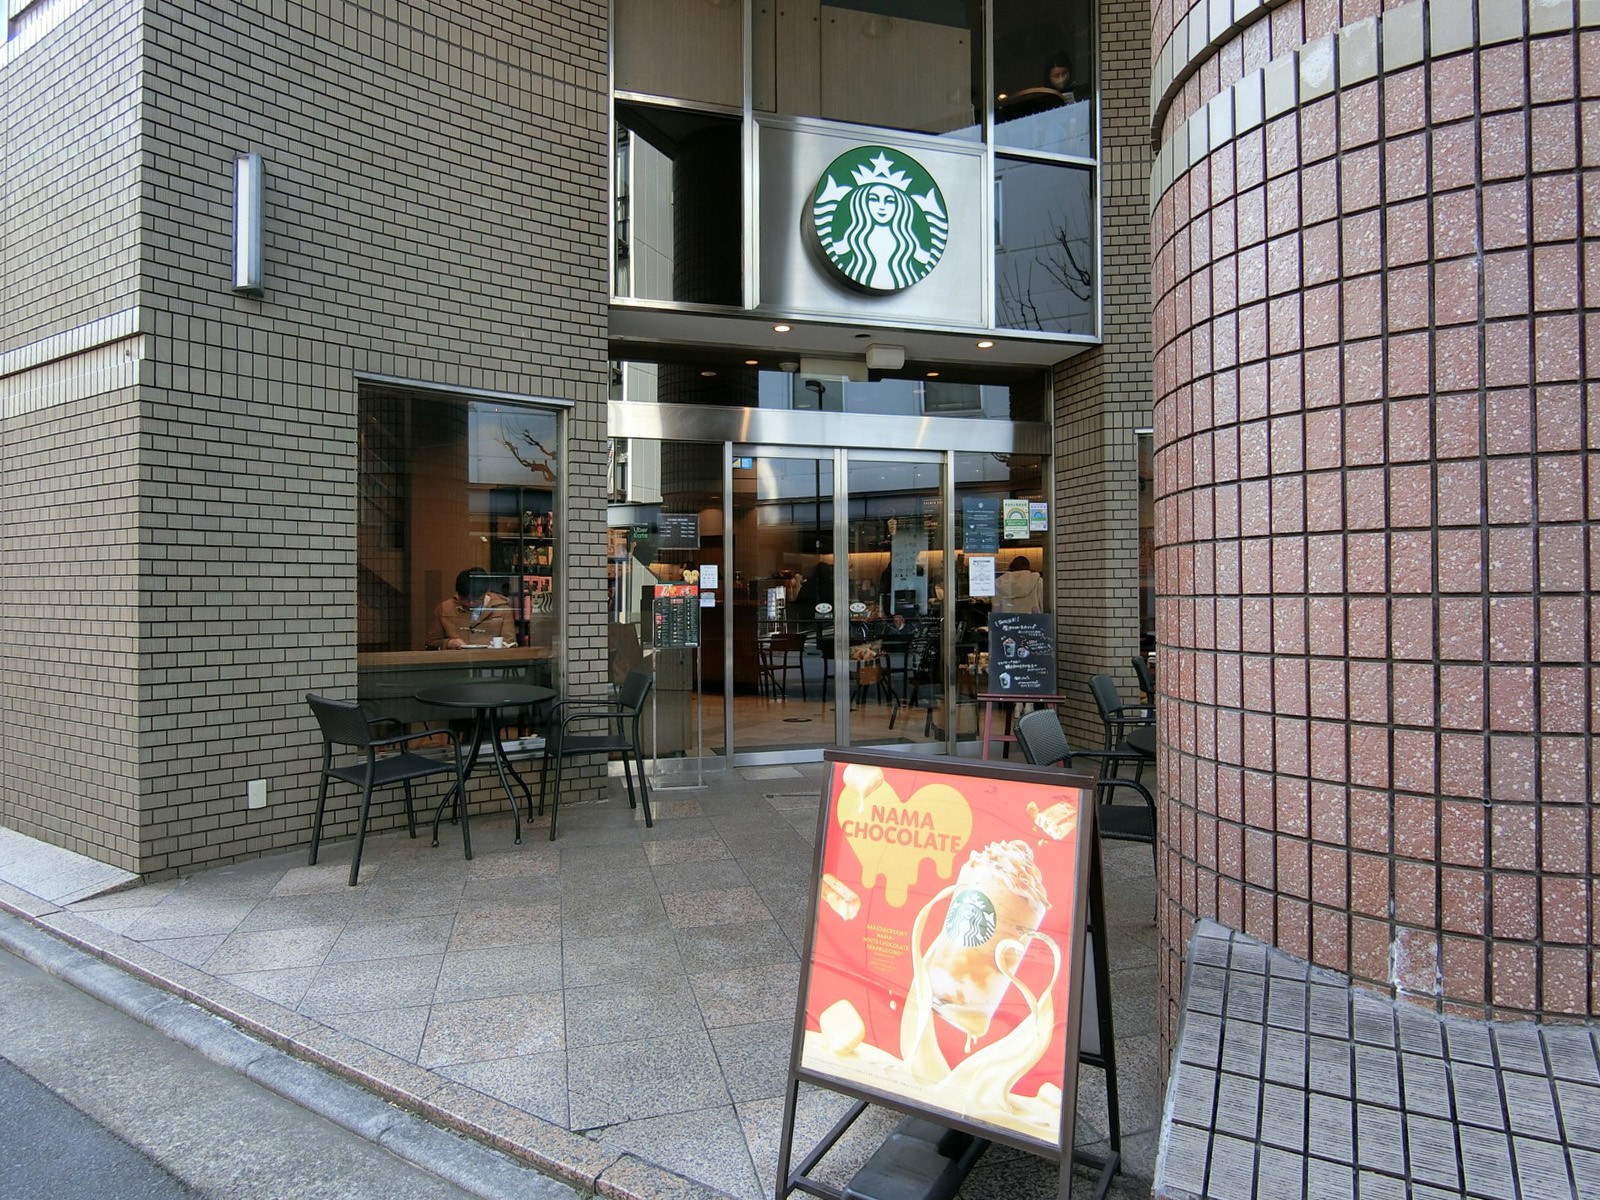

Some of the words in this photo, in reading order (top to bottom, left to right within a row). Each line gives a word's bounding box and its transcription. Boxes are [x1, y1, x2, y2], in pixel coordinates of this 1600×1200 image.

[871, 804, 935, 830] NAMA
[842, 819, 962, 854] CHOCOLATE
[879, 940, 909, 951] CHOCOLATE
